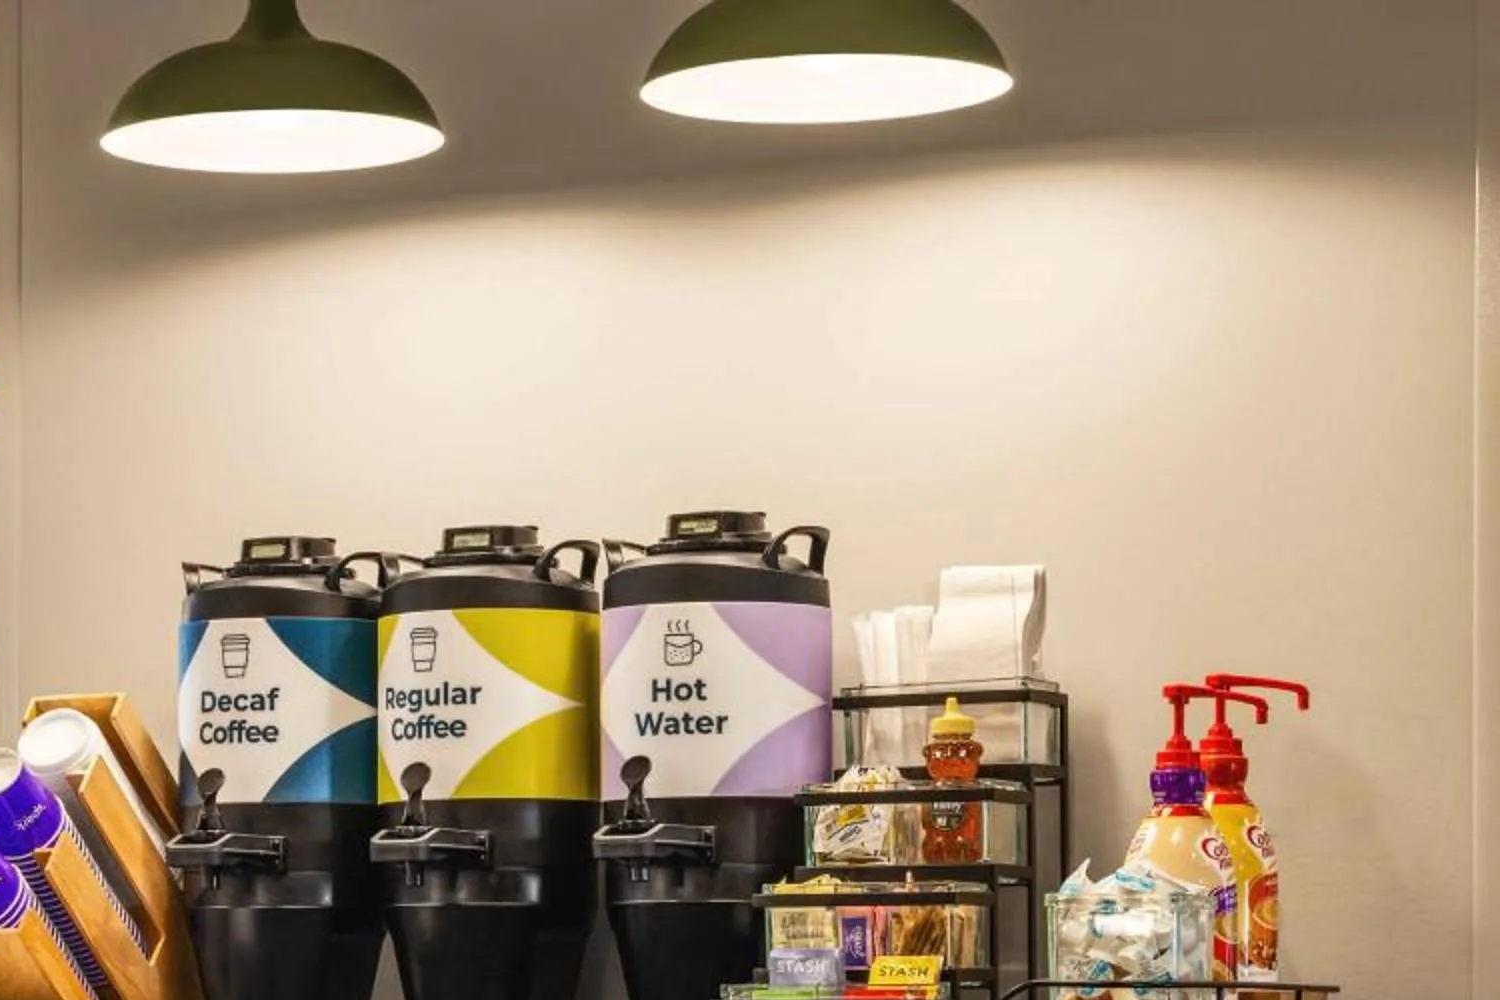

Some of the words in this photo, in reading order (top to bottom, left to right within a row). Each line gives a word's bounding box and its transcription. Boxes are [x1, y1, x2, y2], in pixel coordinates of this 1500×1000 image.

[200, 687, 280, 713] Decaf
[385, 681, 482, 713] Regular
[651, 678, 707, 702] Hot
[199, 720, 280, 745] Coffee
[391, 714, 467, 742] Coffee
[635, 711, 729, 737] Water
[775, 958, 827, 975] STASH
[877, 964, 930, 978] STASH
